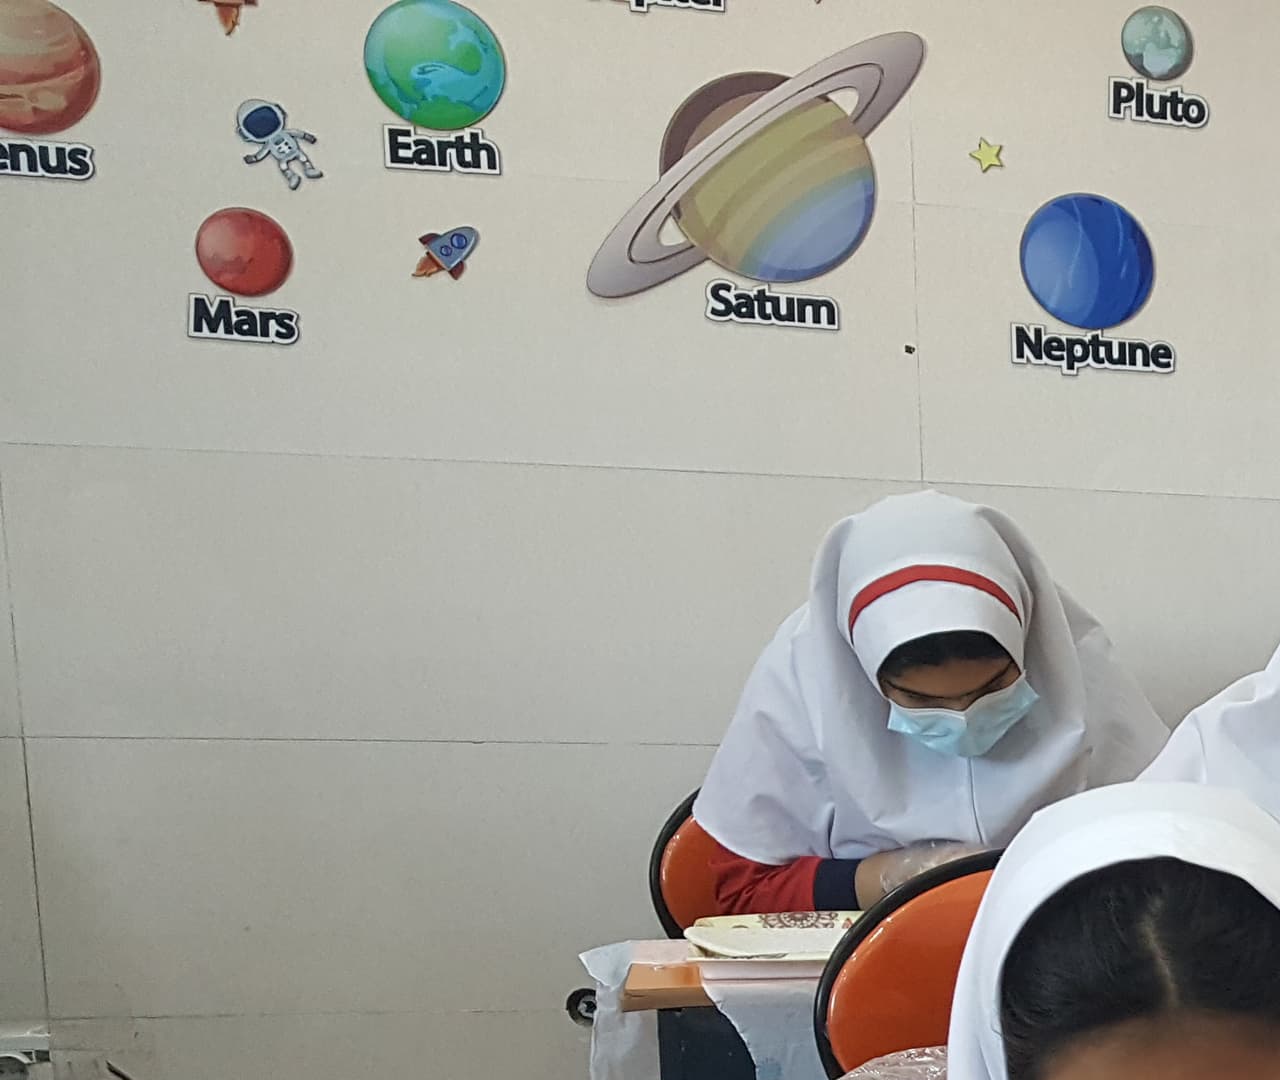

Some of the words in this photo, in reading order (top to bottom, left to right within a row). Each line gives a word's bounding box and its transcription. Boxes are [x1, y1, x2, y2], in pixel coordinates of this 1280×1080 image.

[1113, 80, 1206, 124] Pluto
[0, 142, 90, 176] nus
[388, 127, 497, 170] Earth
[193, 297, 296, 340] Mars
[710, 283, 837, 326] Saturn
[1015, 325, 1173, 371] Neptune
